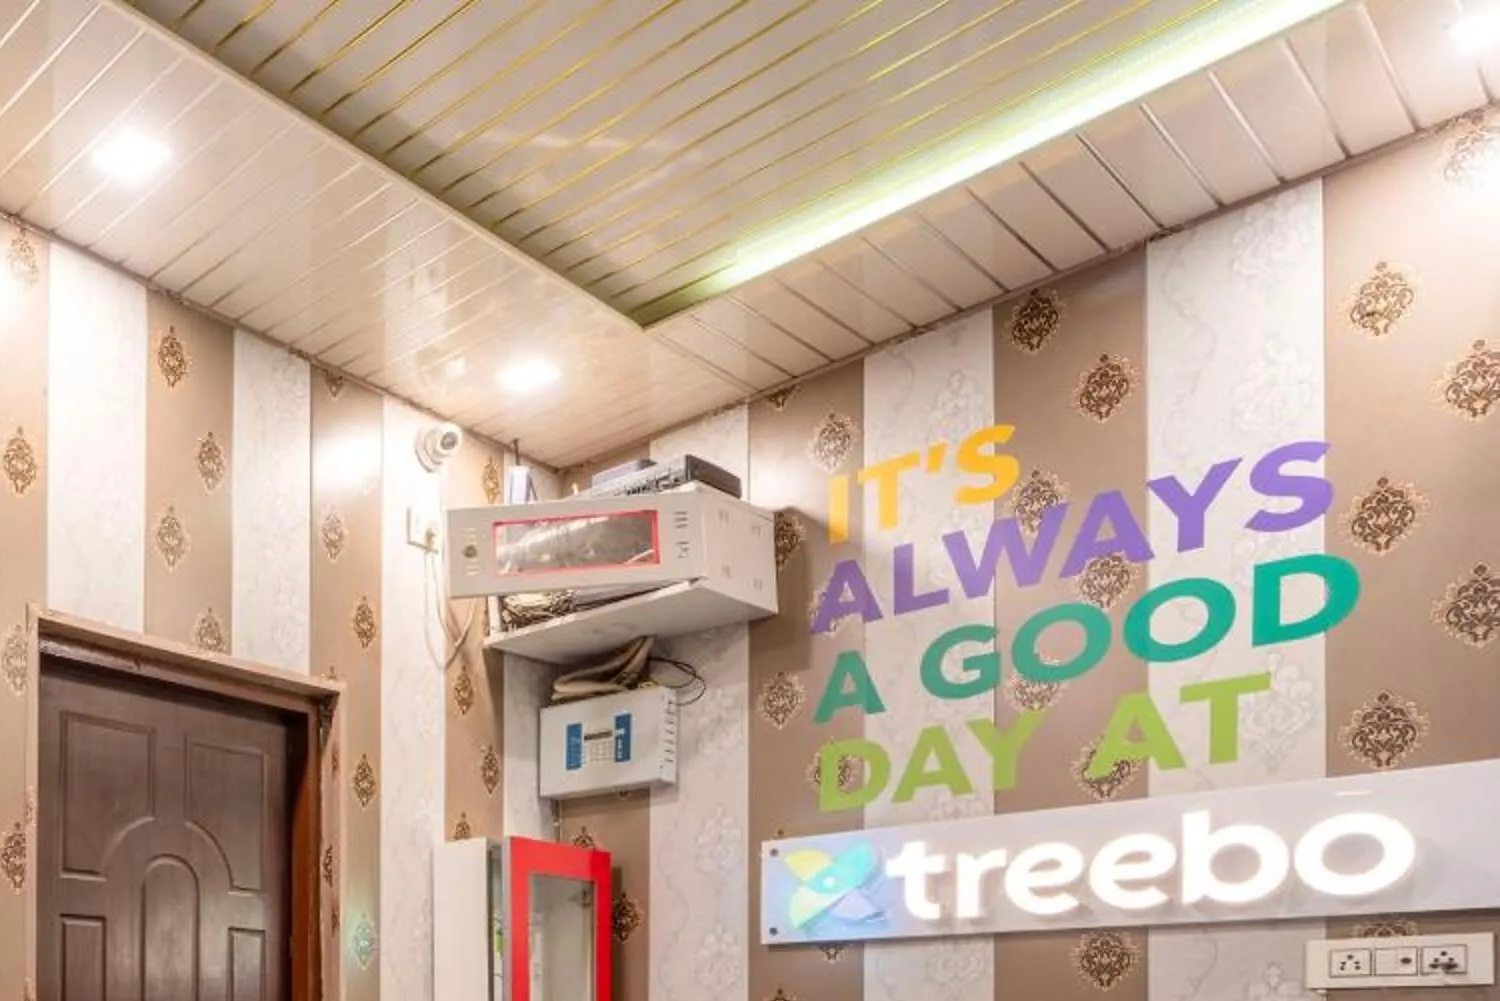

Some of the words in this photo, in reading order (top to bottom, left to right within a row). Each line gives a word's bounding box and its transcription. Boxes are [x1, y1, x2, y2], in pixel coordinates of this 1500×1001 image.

[810, 441, 1335, 636] ALWAYS
[828, 424, 1021, 545] IT'S
[813, 649, 886, 724] A
[919, 553, 1361, 699] GOOD
[818, 710, 1047, 812] DAY
[1084, 672, 1272, 782] AT
[885, 810, 1417, 922] treebo
